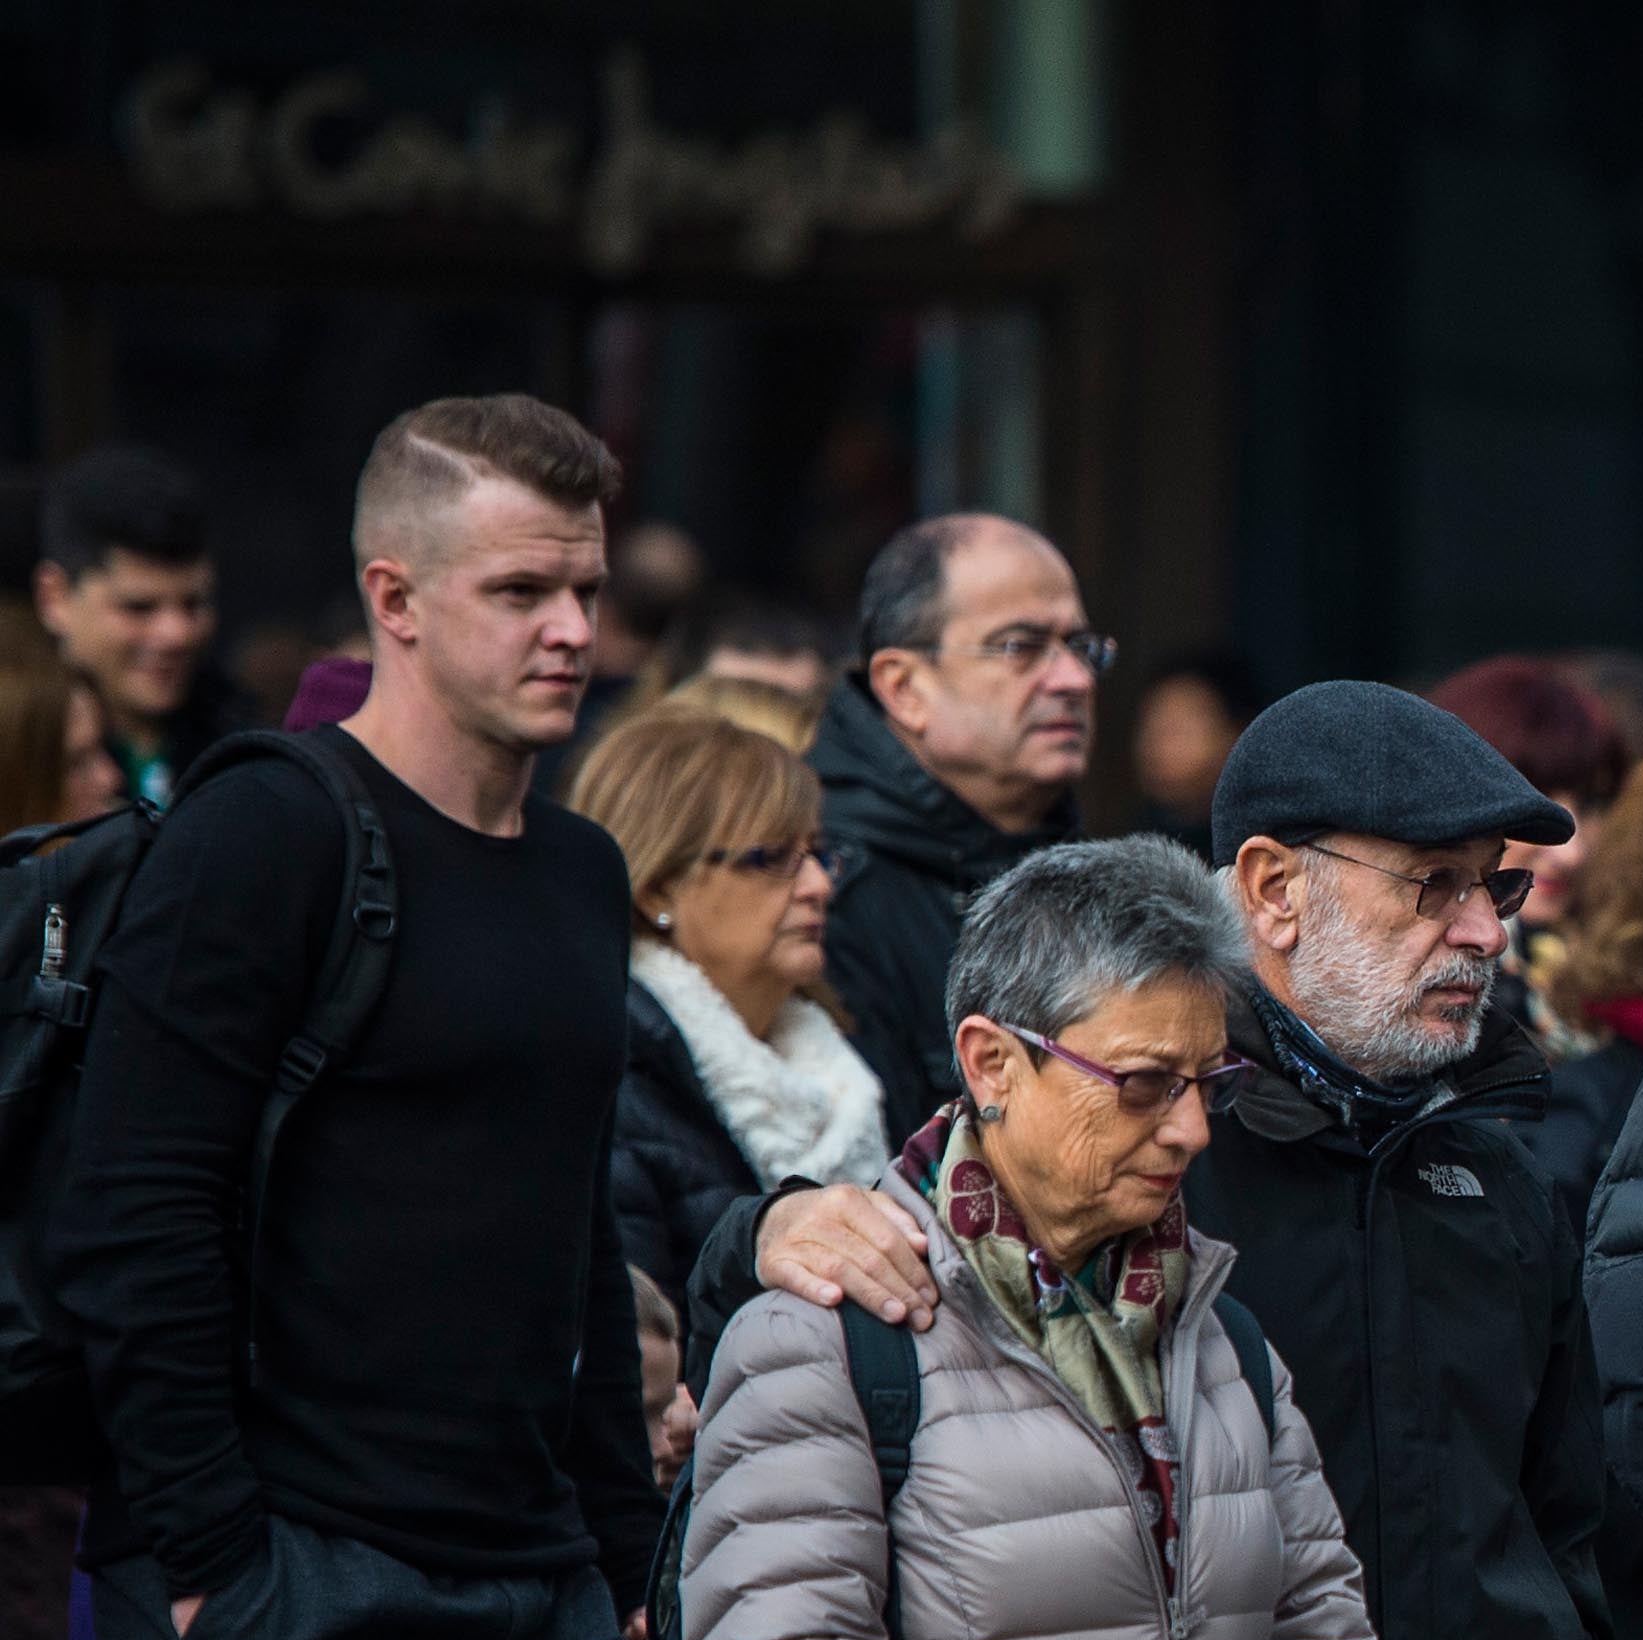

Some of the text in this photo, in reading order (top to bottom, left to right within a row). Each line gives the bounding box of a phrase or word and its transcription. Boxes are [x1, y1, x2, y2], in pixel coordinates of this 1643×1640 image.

[1428, 1162, 1453, 1175] THE
[1417, 1168, 1457, 1186] NORTH
[1432, 1185, 1461, 1197] FACE
